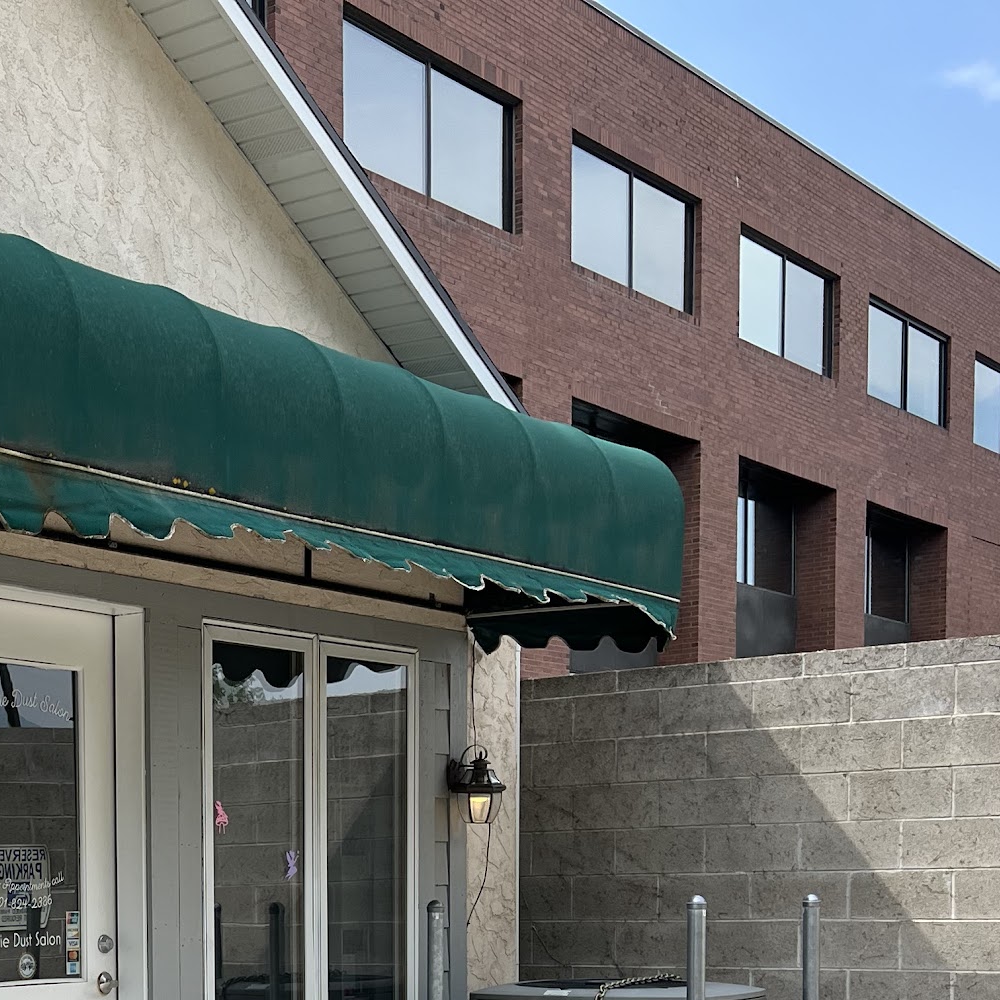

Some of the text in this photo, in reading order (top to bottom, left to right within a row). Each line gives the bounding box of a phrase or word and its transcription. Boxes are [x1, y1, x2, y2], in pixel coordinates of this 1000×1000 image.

[10, 688, 38, 709] Dust
[39, 694, 70, 722] Salon
[13, 932, 32, 948] Dust
[35, 930, 61, 947] Salon
